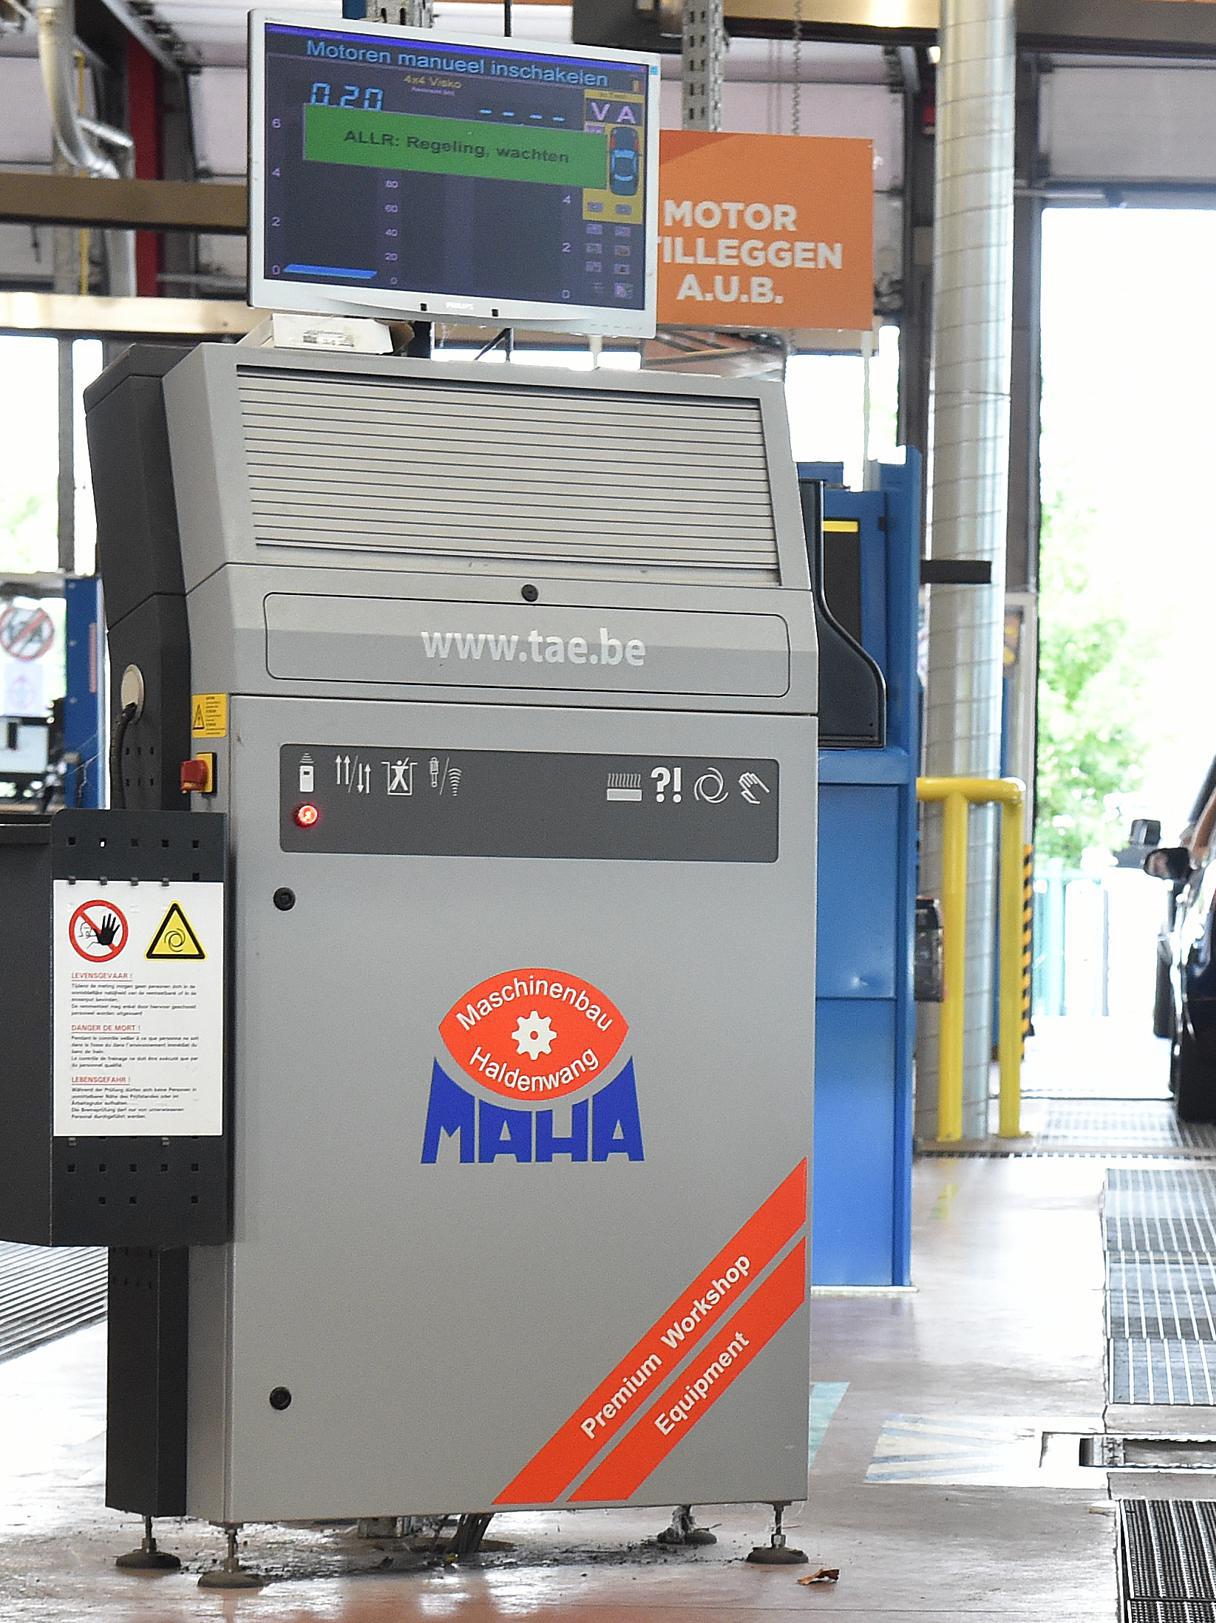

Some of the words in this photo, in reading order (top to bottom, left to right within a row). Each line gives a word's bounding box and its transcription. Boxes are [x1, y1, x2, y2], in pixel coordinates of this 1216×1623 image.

[306, 39, 391, 64] Motoren
[398, 53, 485, 74] manueel
[491, 61, 609, 87] inschakelen
[343, 130, 399, 147] ALLR:
[496, 147, 570, 163] wachten
[271, 167, 281, 177] 4
[562, 194, 572, 204] 4
[271, 216, 281, 227] 2
[664, 200, 798, 232] MOTOR
[385, 229, 399, 237] 40
[561, 242, 571, 253] 2
[385, 252, 399, 261] 20
[658, 236, 842, 269] ILLEGGEN
[271, 264, 281, 275] 0
[561, 289, 571, 299] 0
[676, 273, 785, 304] A.U.B.
[421, 627, 647, 667] www.tae.be
[455, 975, 613, 1032] Maschinenbau
[469, 1046, 599, 1092] Haldenwang
[421, 1055, 645, 1164] MAHA
[580, 1352, 663, 1440] Premium
[660, 1255, 751, 1350] Workshop
[653, 1330, 750, 1436] Equipment
